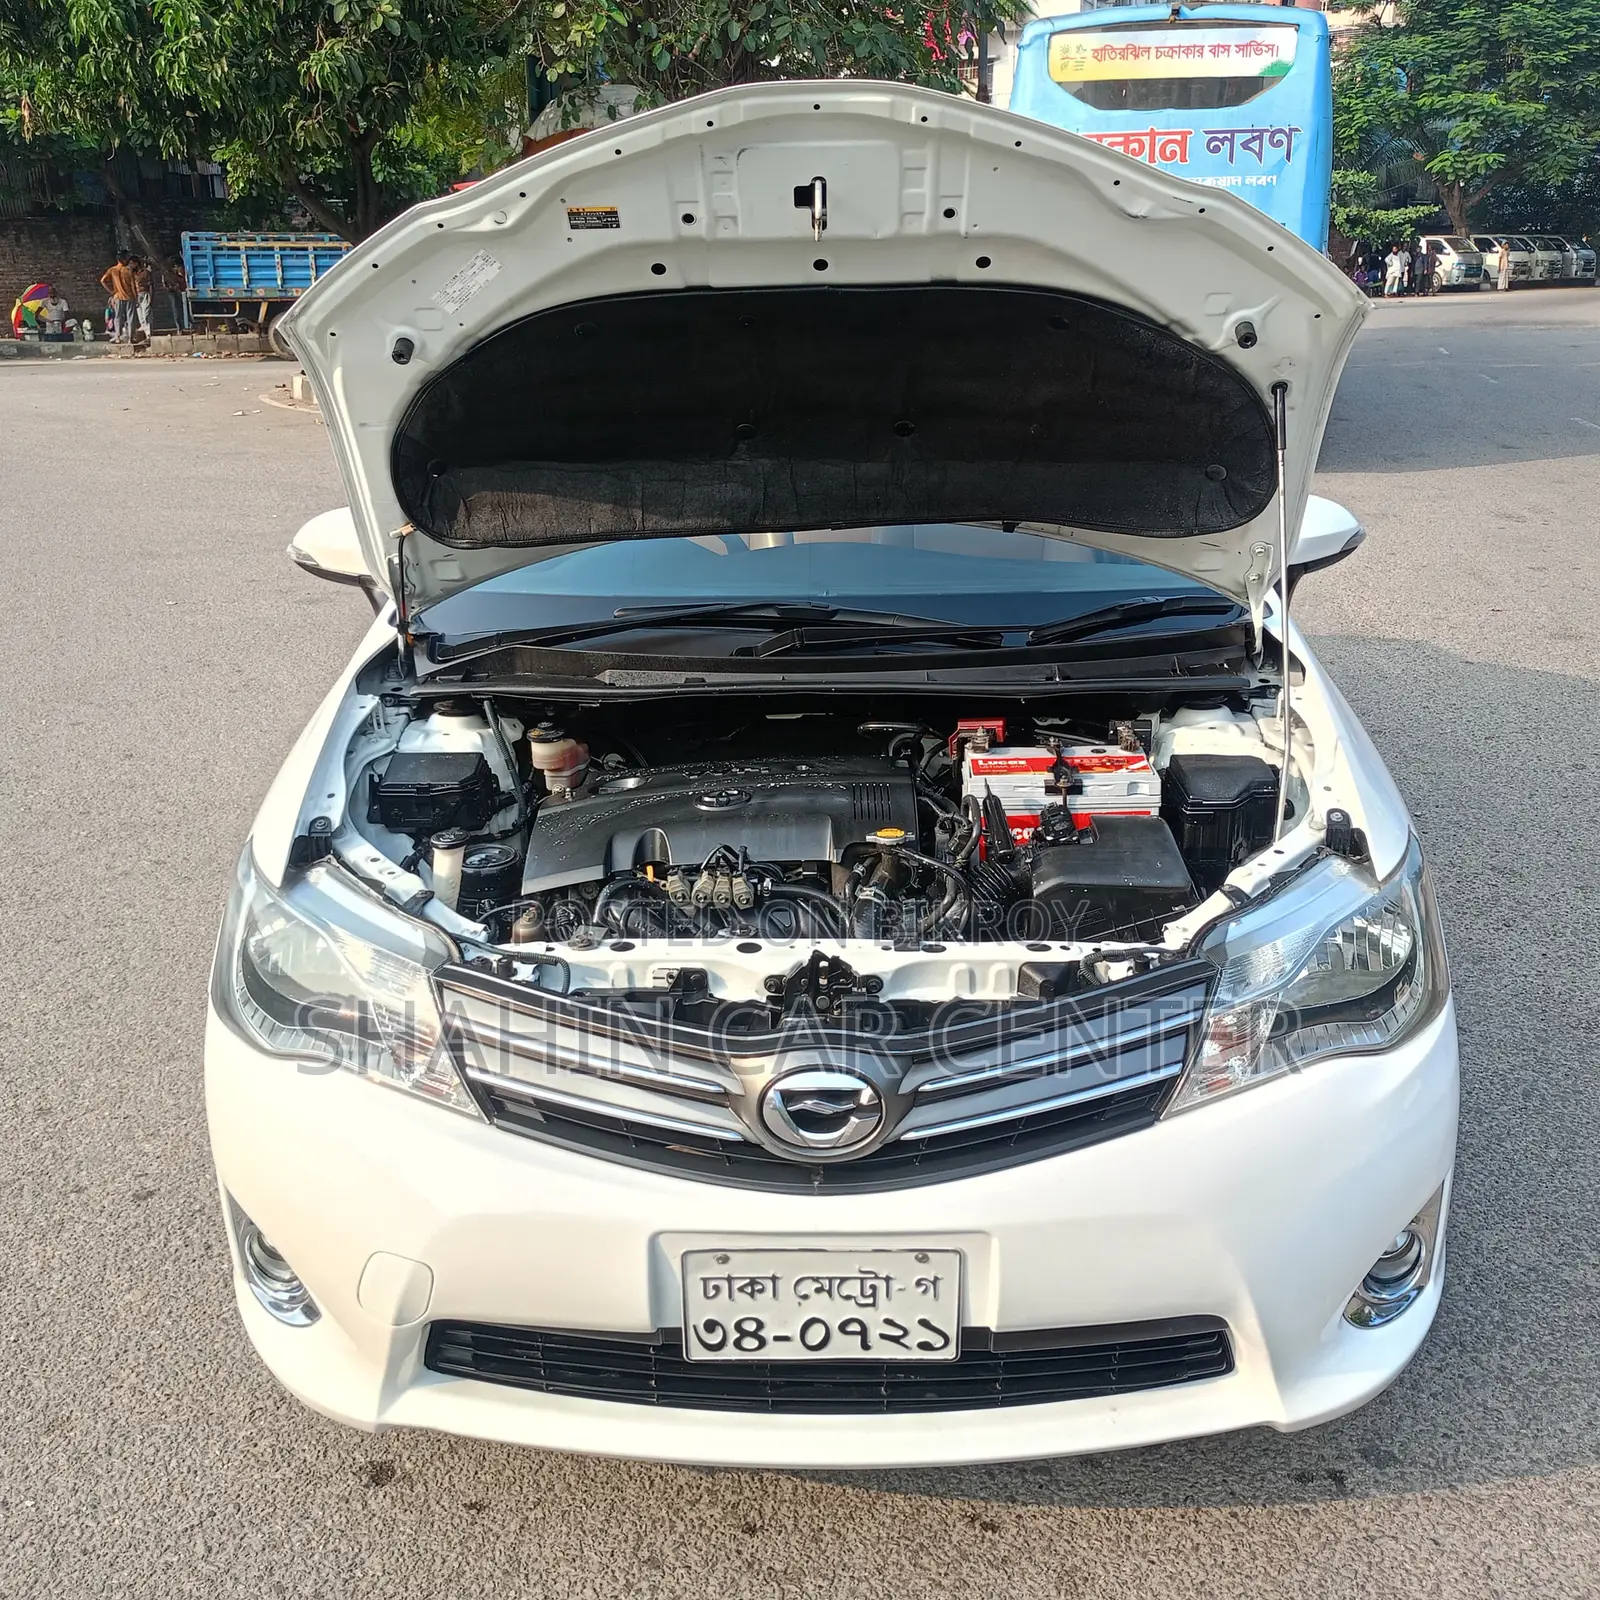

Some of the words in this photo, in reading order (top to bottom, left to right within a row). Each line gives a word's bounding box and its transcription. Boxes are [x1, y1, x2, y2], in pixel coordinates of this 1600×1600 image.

[1092, 43, 1151, 62] হাতিরঝিল
[1155, 44, 1204, 60] চক্রাকার
[1208, 43, 1231, 59] বাস
[1202, 127, 1302, 165] লবণ
[1245, 175, 1277, 187] লবণ
[699, 1274, 782, 1301] ঢাকা
[692, 1316, 950, 1352] ৩৪-০৭২১
